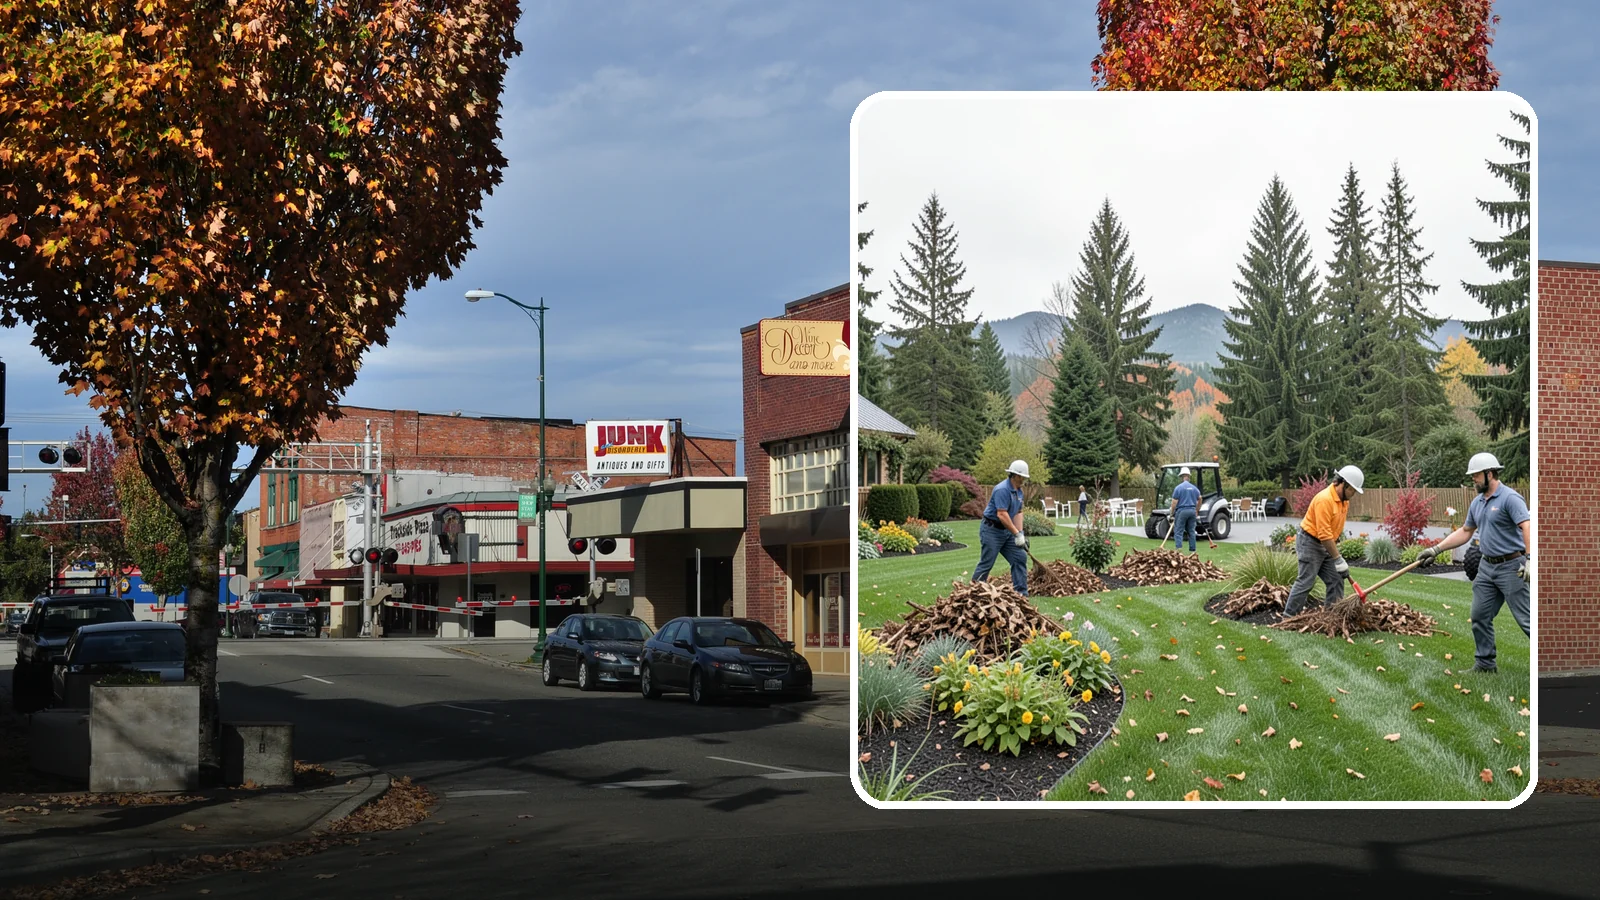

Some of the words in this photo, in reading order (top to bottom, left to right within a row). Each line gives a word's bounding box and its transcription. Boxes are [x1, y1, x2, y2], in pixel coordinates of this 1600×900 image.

[765, 327, 831, 365] Decor
[595, 425, 665, 457] JUNK
[607, 446, 646, 454] DISORDERLY
[597, 461, 628, 470] ANTIQUES
[631, 460, 644, 470] AND
[647, 460, 665, 469] GIFTS
[390, 521, 413, 539] Trackside
[414, 519, 429, 534] Pizza
